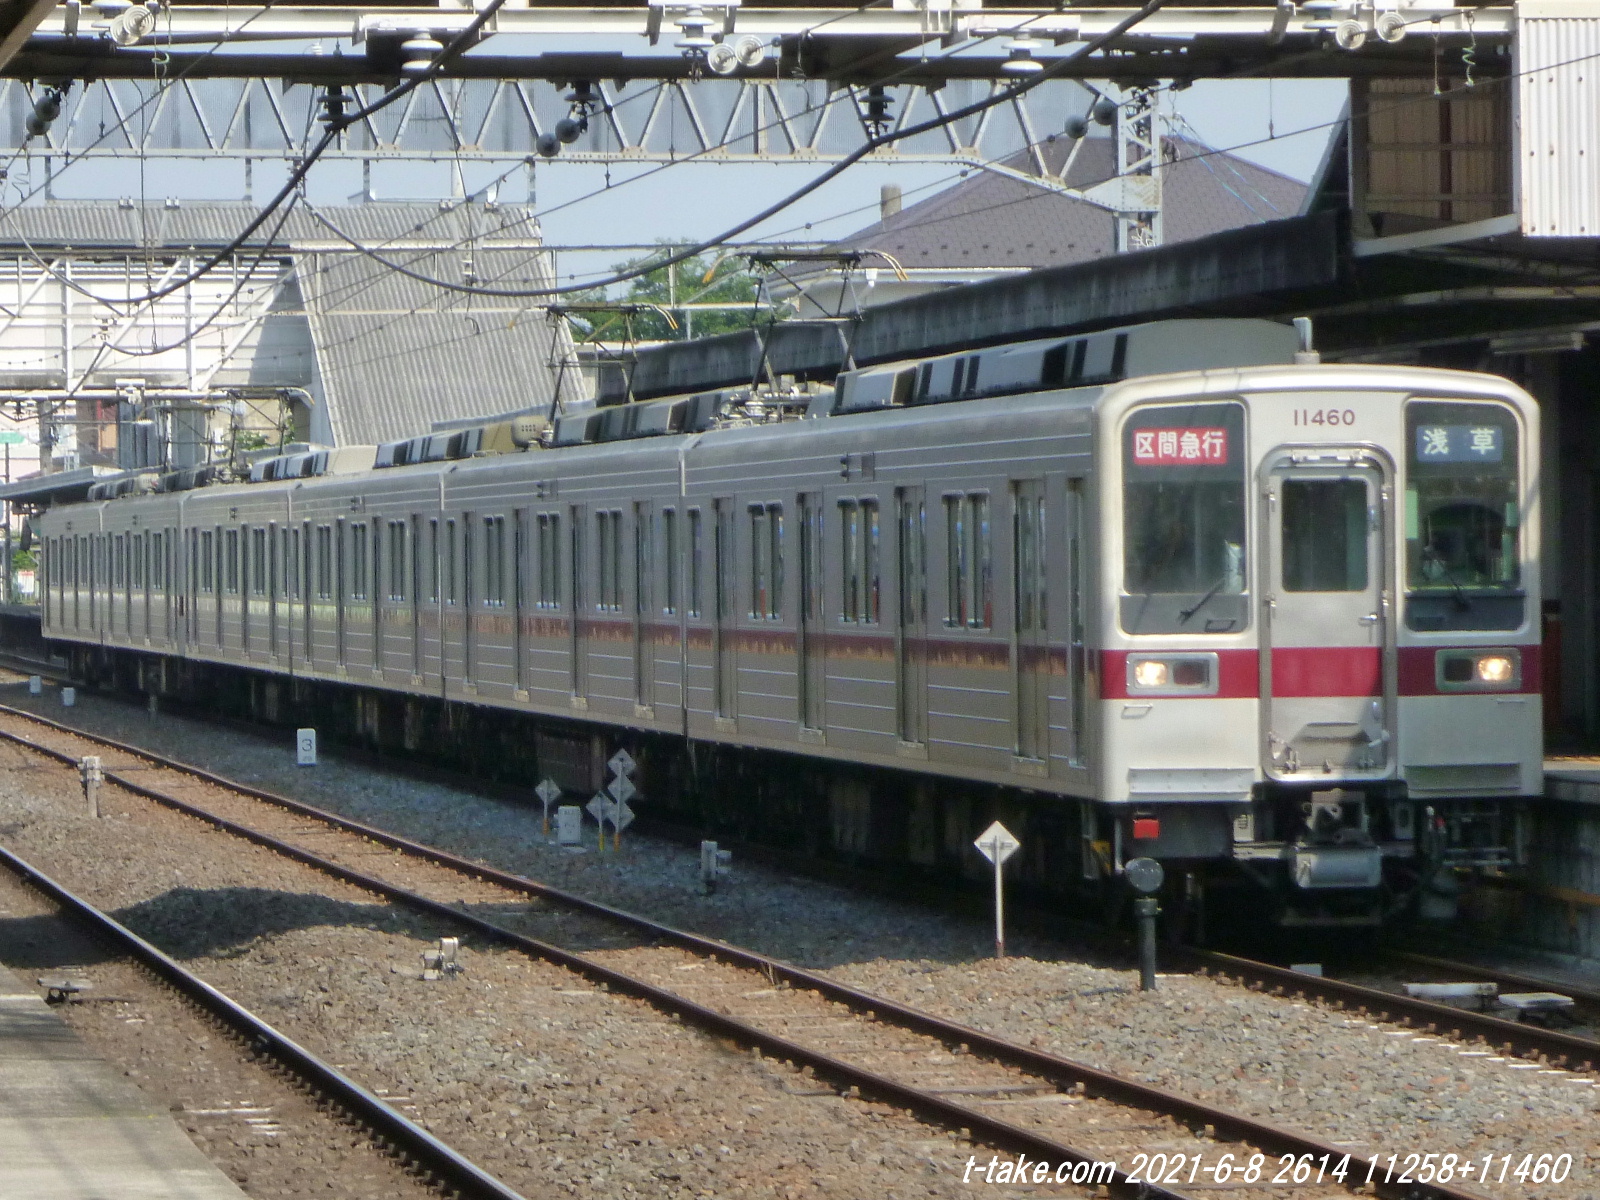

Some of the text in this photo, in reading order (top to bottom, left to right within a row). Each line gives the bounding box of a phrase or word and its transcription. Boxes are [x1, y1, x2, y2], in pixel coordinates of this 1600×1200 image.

[1294, 409, 1356, 426] 11460
[1136, 431, 1224, 458] 区間急行
[1423, 428, 1496, 455] 浅草
[301, 738, 313, 752] 3
